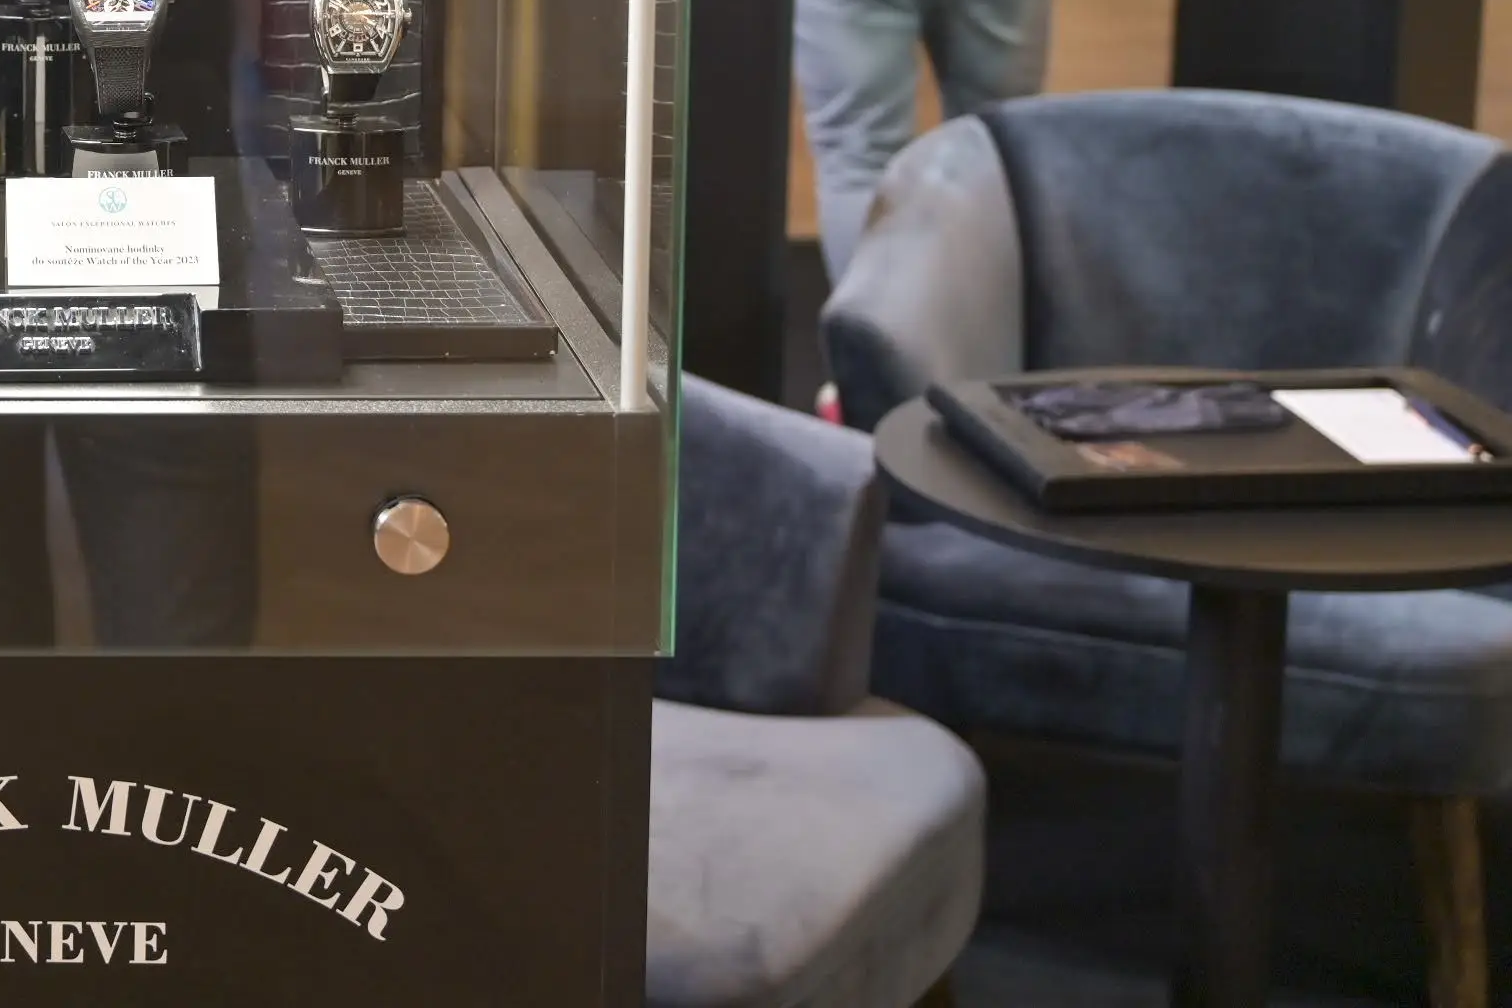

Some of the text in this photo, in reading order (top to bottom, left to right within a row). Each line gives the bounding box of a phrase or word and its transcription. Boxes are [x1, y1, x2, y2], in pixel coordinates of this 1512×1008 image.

[43, 42, 81, 52] MULLER
[309, 156, 390, 166] FRANCK MULLER
[88, 168, 174, 179] FRANCK MULLER
[32, 256, 45, 266] do
[86, 257, 118, 266] Watch
[120, 256, 131, 266] of
[133, 256, 148, 266] the
[150, 256, 173, 266] Year
[176, 255, 200, 265] 2023
[53, 306, 175, 326] MULLER
[21, 336, 93, 351] GENEVE
[61, 774, 406, 942] MULLER
